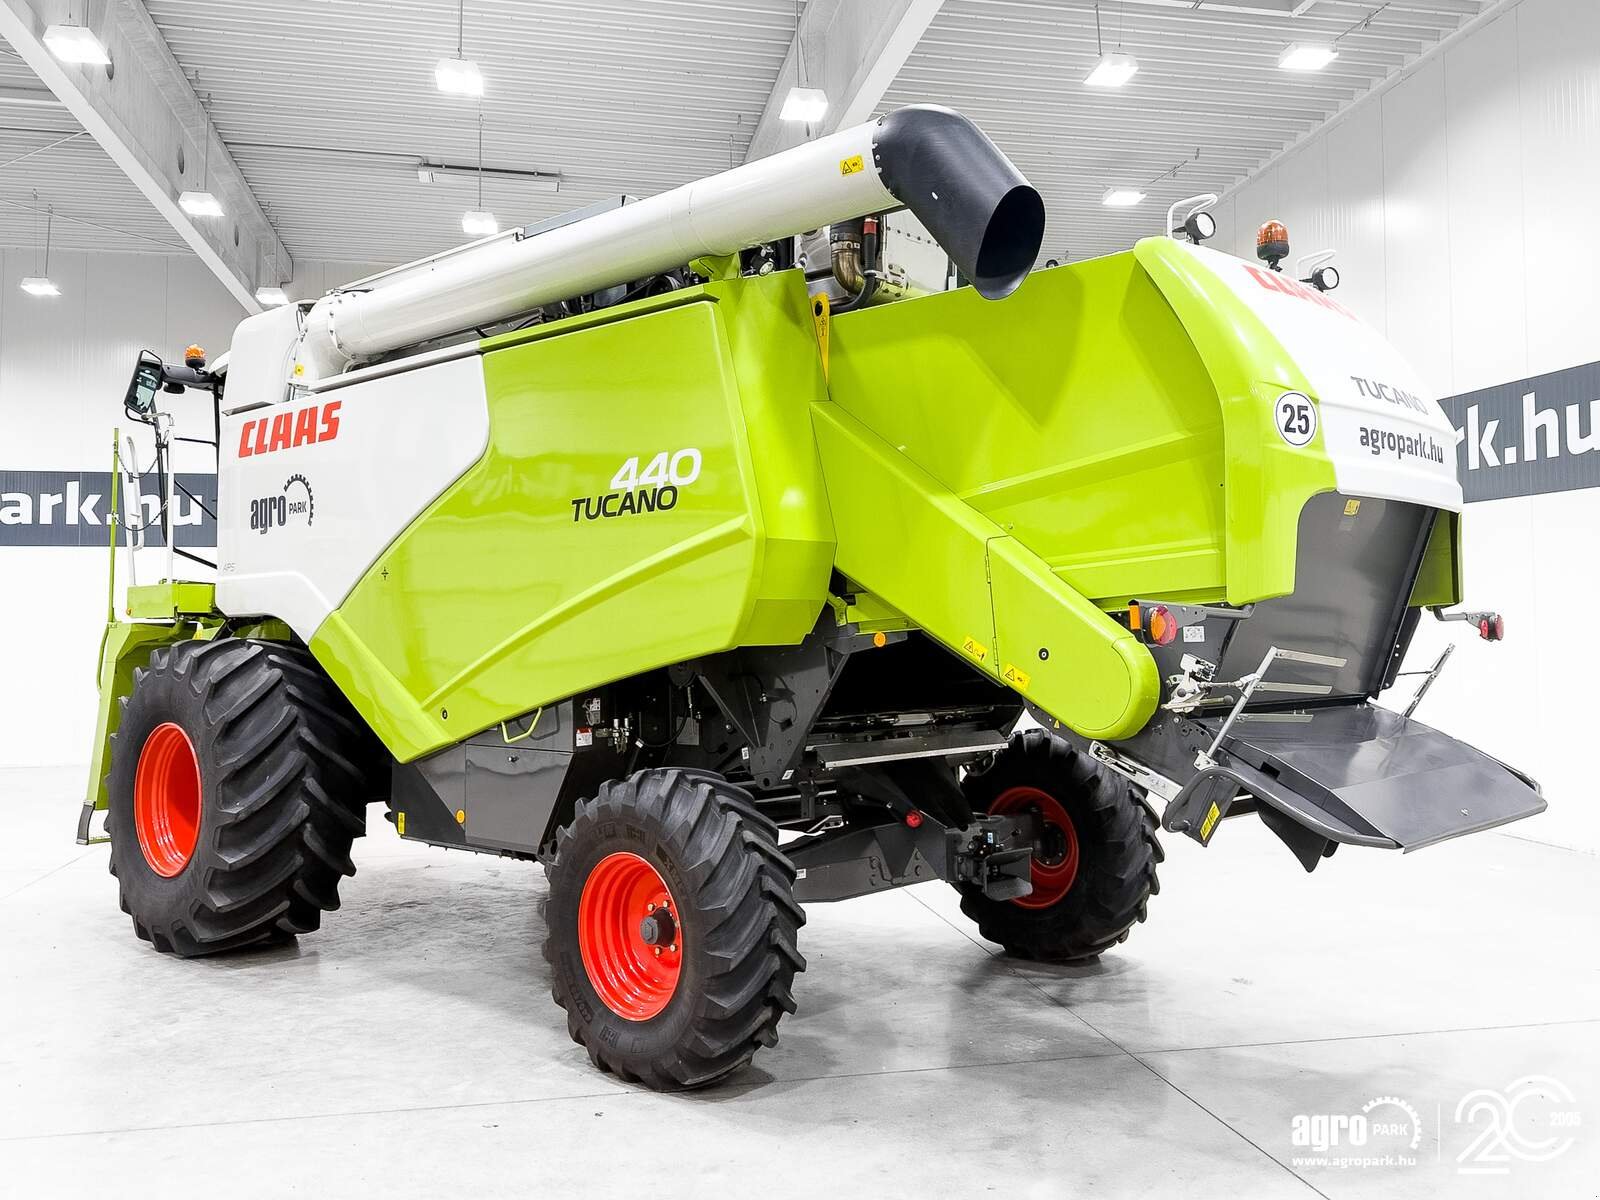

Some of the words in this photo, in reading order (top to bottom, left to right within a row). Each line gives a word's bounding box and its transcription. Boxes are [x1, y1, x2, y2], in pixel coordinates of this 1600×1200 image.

[1350, 376, 1429, 415] TUCANO
[238, 401, 342, 458] CLAAS
[1282, 404, 1310, 434] 25
[1359, 426, 1444, 465] agropark.hu
[609, 448, 703, 494] 440
[250, 495, 287, 535] agro
[288, 501, 308, 515] PARK
[571, 485, 678, 522] TUCANO
